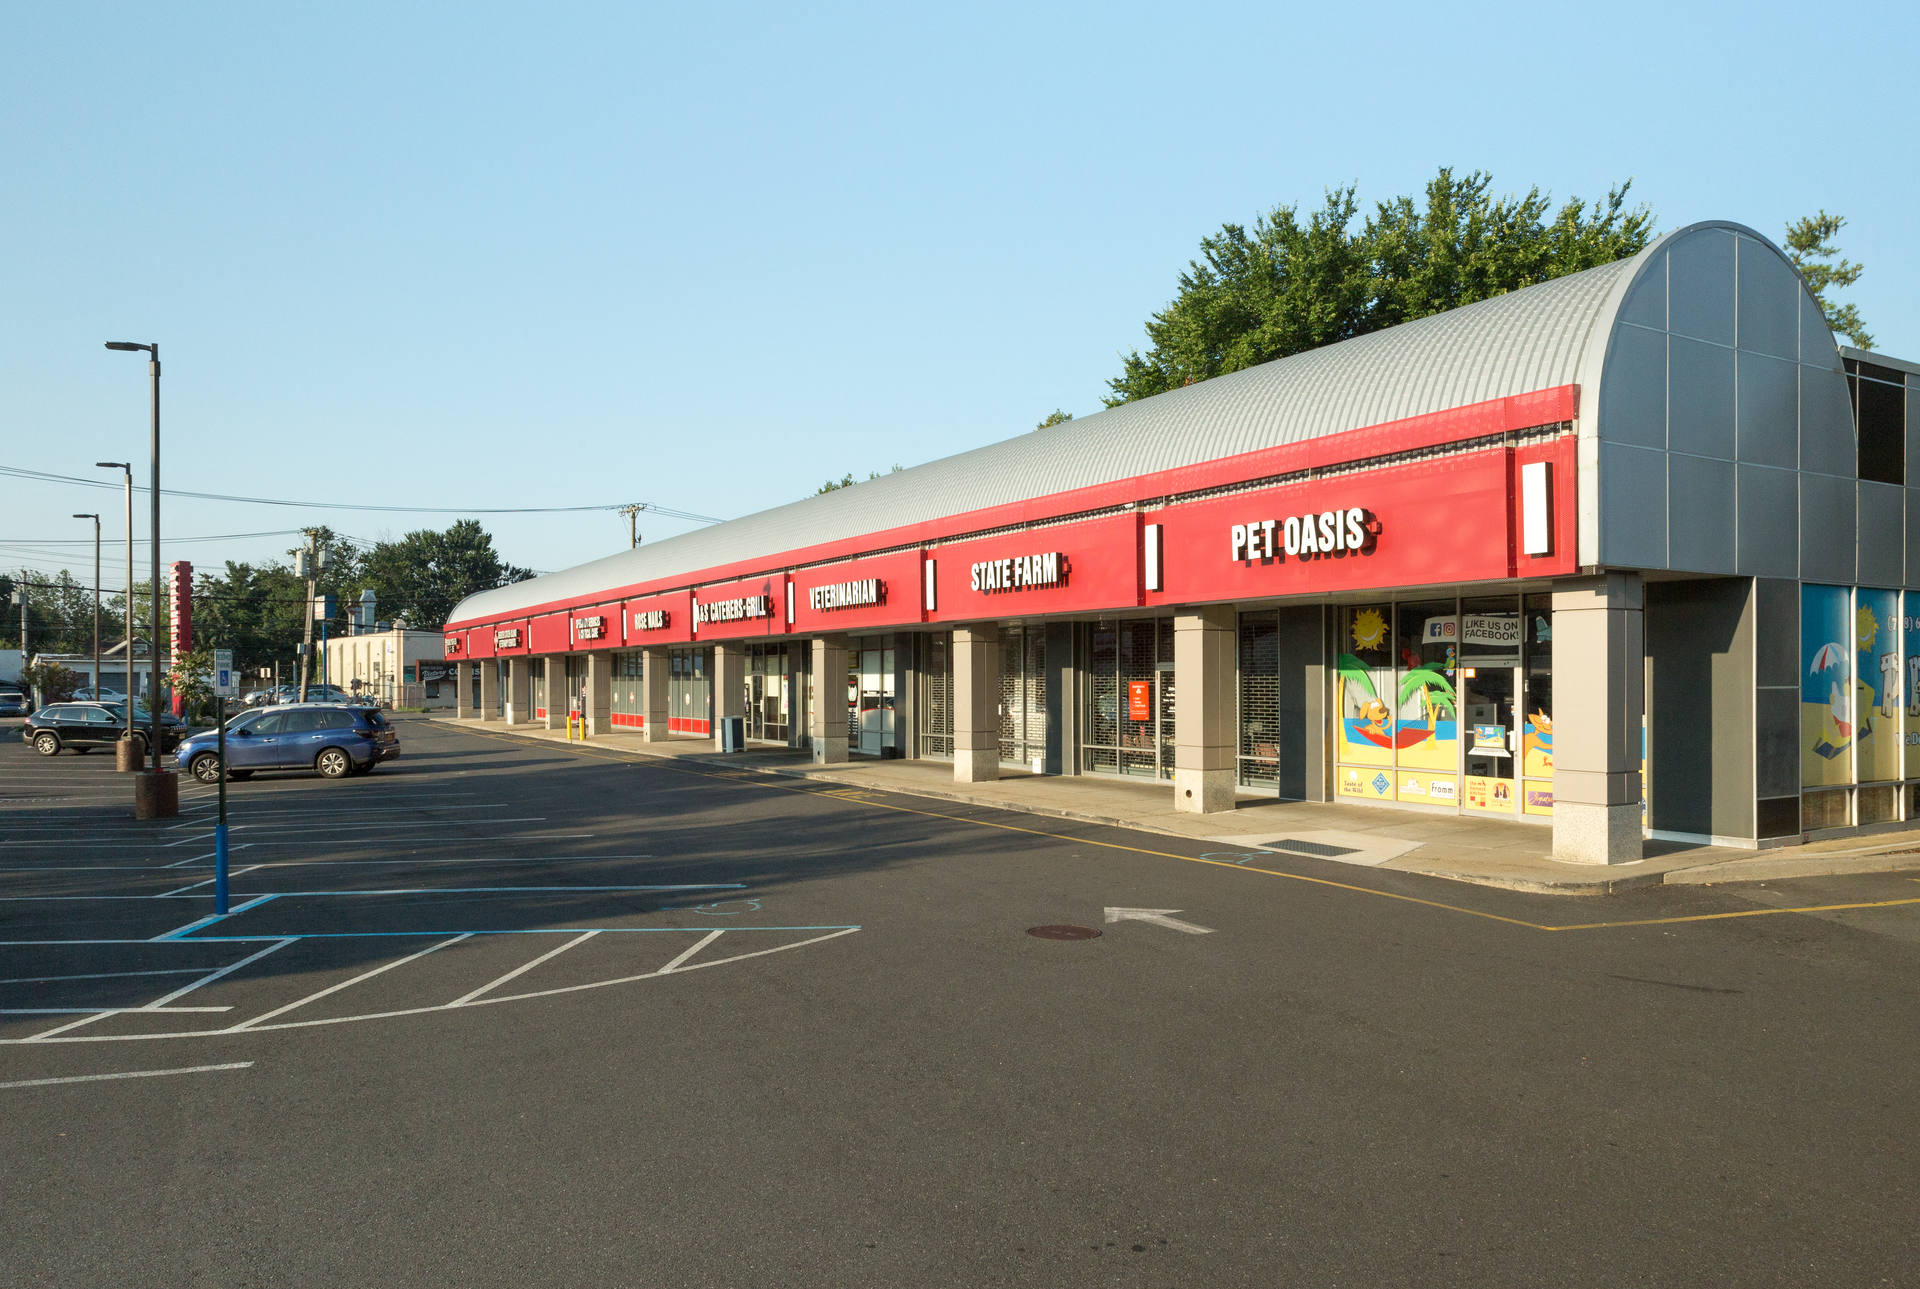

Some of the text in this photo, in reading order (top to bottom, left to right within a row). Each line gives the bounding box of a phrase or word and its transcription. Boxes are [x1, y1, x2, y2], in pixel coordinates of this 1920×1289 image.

[1231, 507, 1365, 562] PET OASIS
[970, 552, 1058, 592] STATE FARM
[809, 578, 878, 610] VETERINARIAN
[647, 610, 663, 629] NAILS
[1465, 619, 1518, 631] LIKE US ON
[1464, 629, 1519, 641] FACEBOOK!
[1431, 782, 1454, 794] fromm
